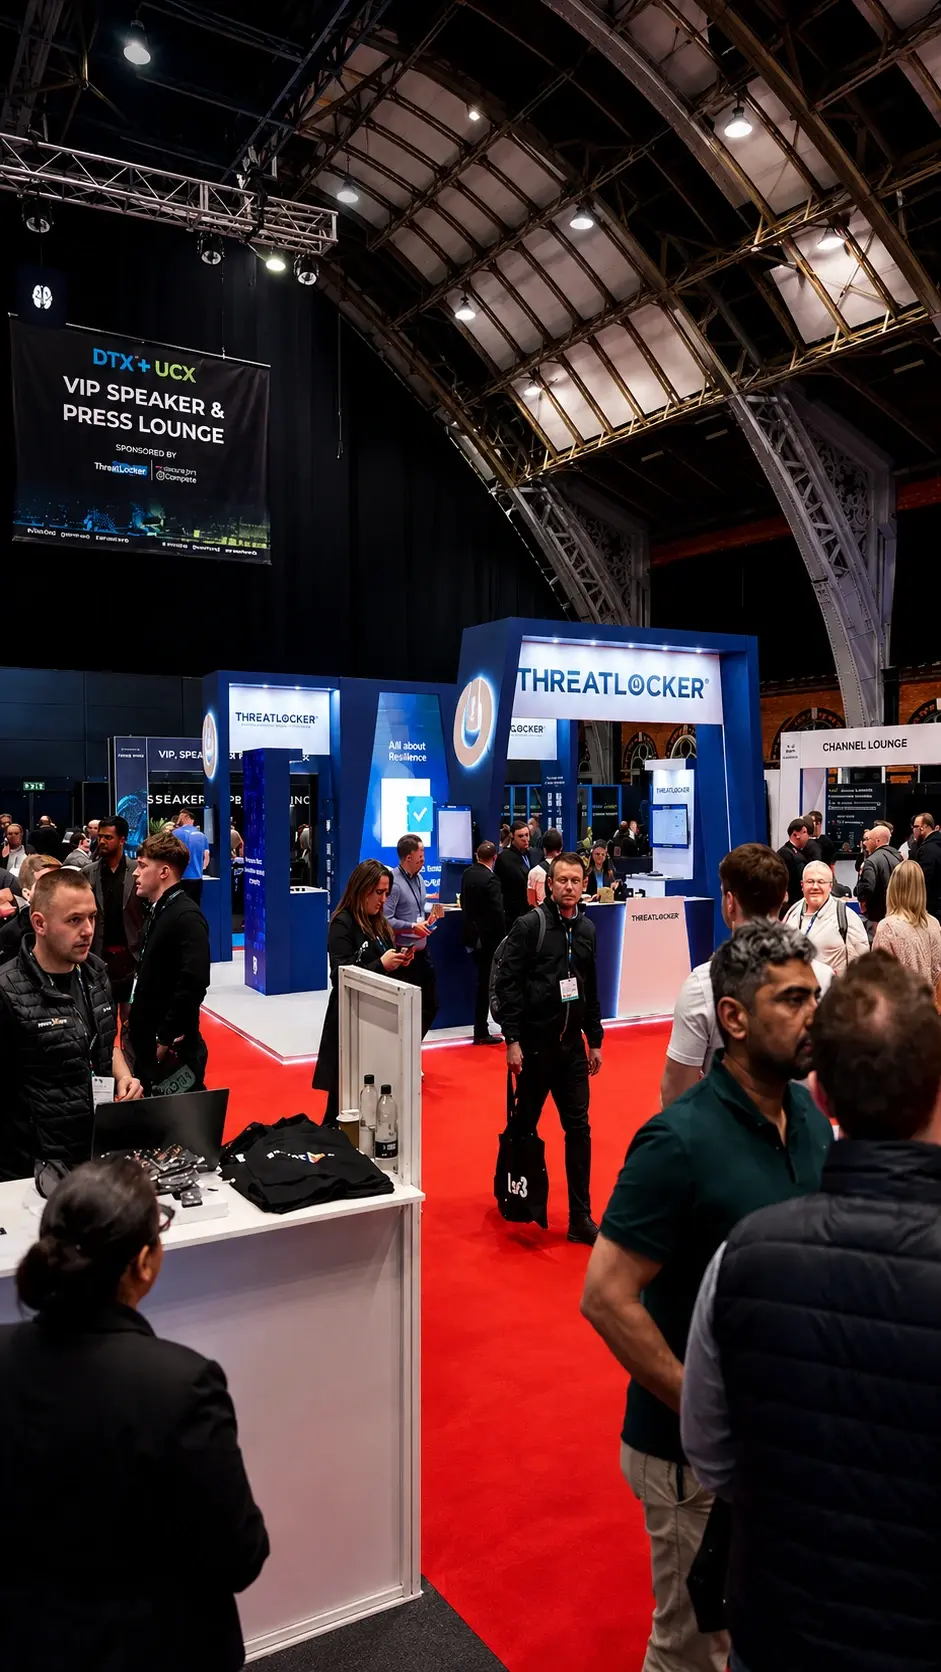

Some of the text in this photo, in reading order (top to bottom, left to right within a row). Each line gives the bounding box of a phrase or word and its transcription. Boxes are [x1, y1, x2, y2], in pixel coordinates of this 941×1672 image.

[93, 348, 134, 372] DTX
[155, 360, 197, 384] UCX
[63, 375, 225, 419] VIP SPEAKER &
[63, 403, 225, 445] PRESS LOUNGE
[115, 443, 177, 459] SPONSORED BY
[403, 741, 427, 751] about
[822, 738, 908, 752] CHANNEL LOUNGE
